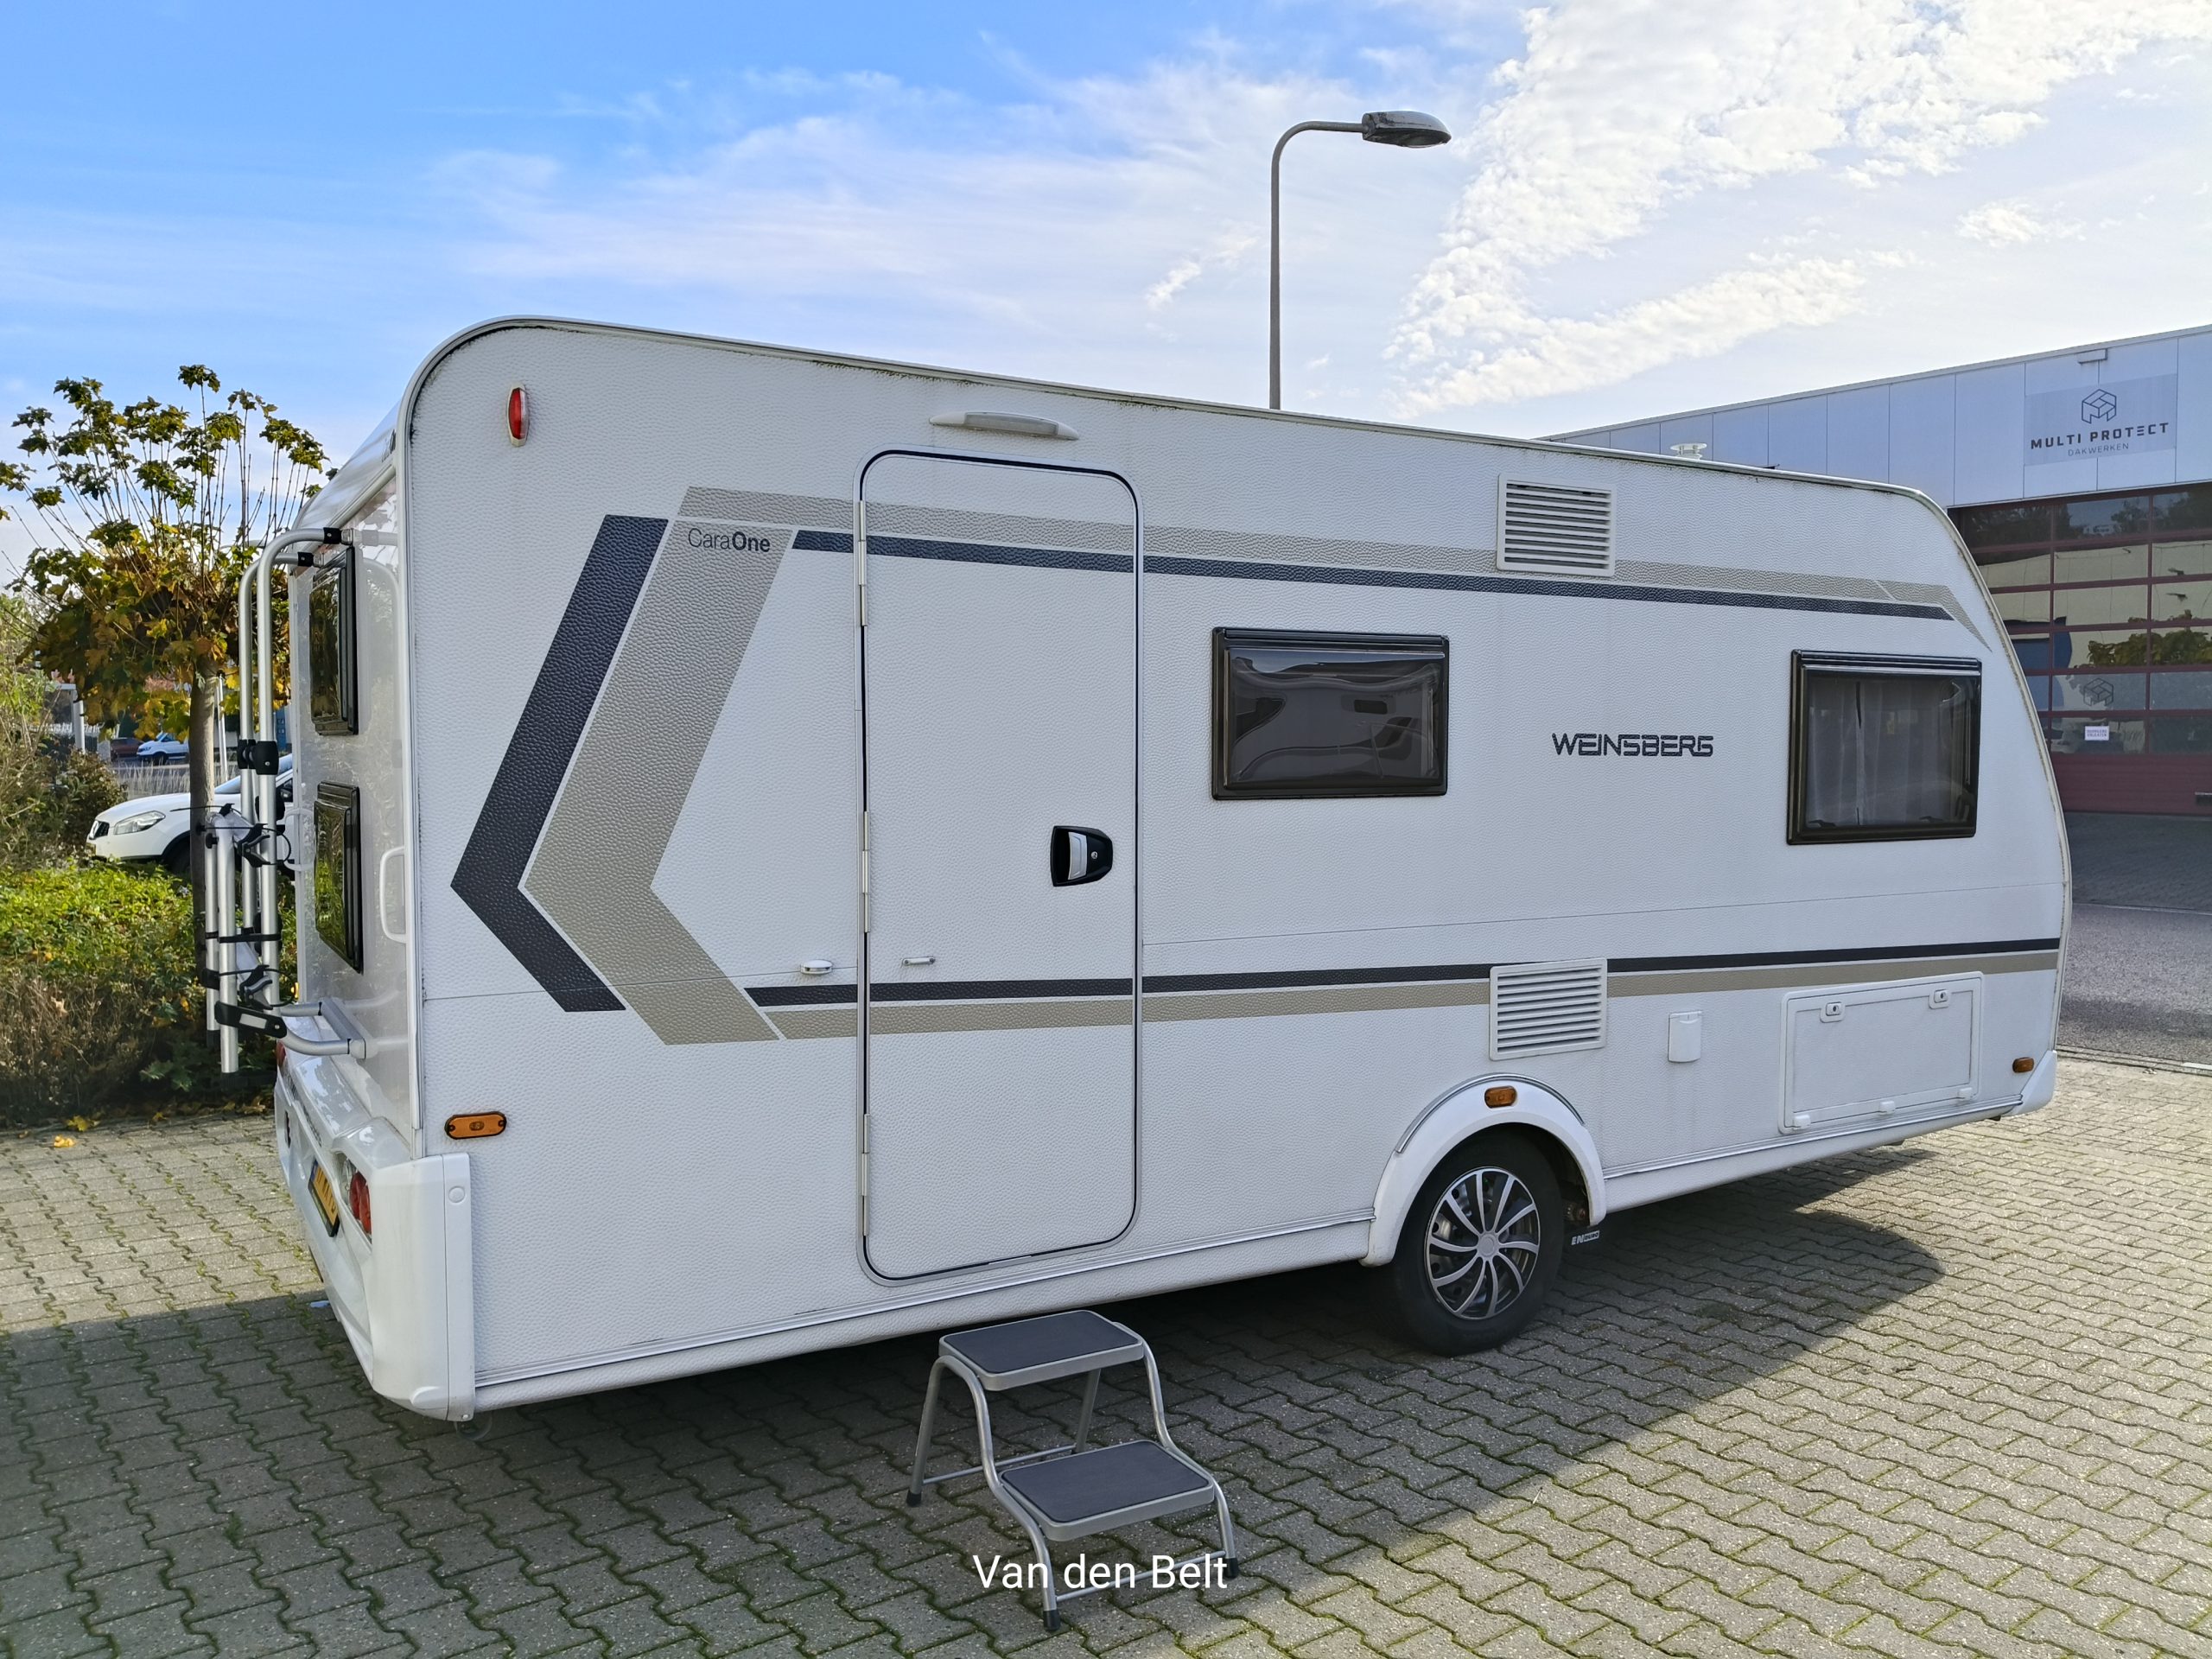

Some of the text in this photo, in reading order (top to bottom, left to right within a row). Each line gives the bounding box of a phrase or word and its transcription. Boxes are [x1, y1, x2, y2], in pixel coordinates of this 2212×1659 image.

[2031, 423, 2169, 449] MULTI PROTECT
[2068, 442, 2129, 456] DAKWERKEN
[688, 528, 771, 553] CaraOne
[1552, 733, 1714, 757] WEINSBERG
